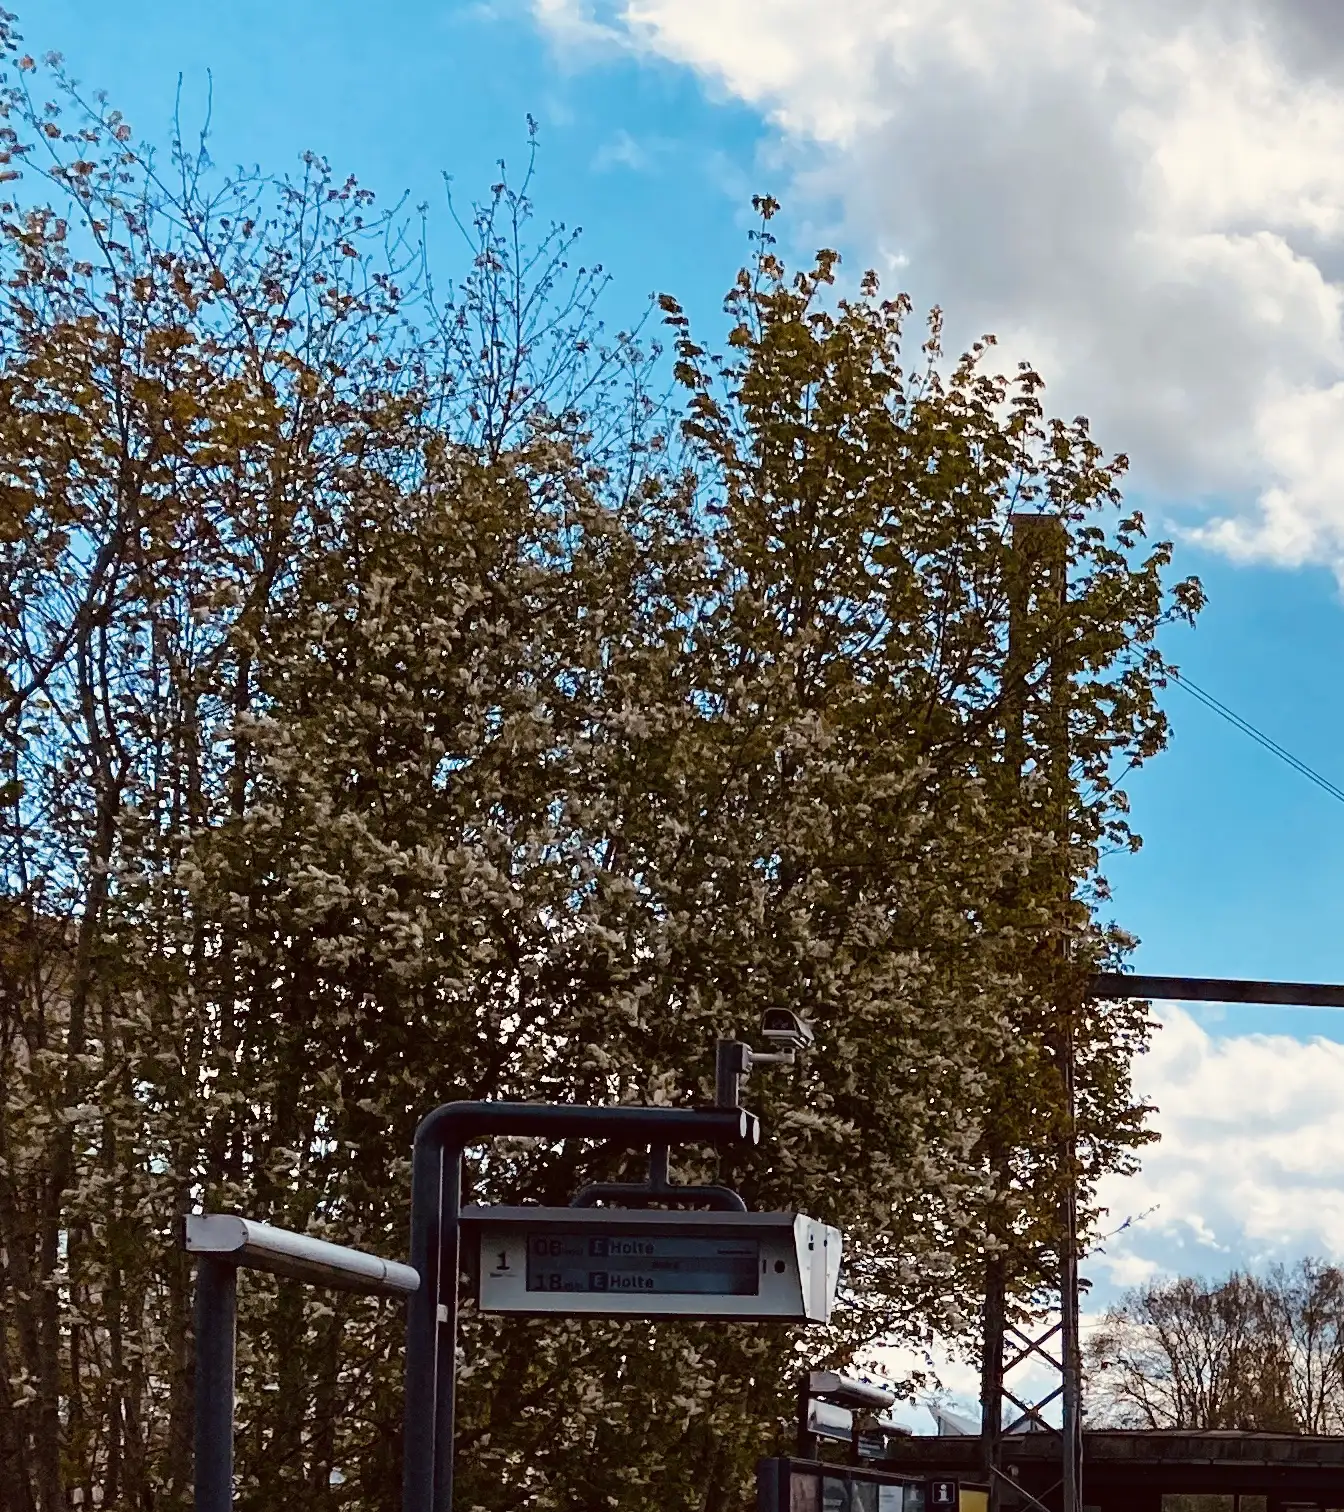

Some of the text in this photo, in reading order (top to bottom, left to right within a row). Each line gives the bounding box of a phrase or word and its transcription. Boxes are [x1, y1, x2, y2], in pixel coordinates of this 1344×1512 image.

[610, 1240, 654, 1254] Holte
[496, 1252, 510, 1270] 1
[610, 1275, 654, 1289] Holte
